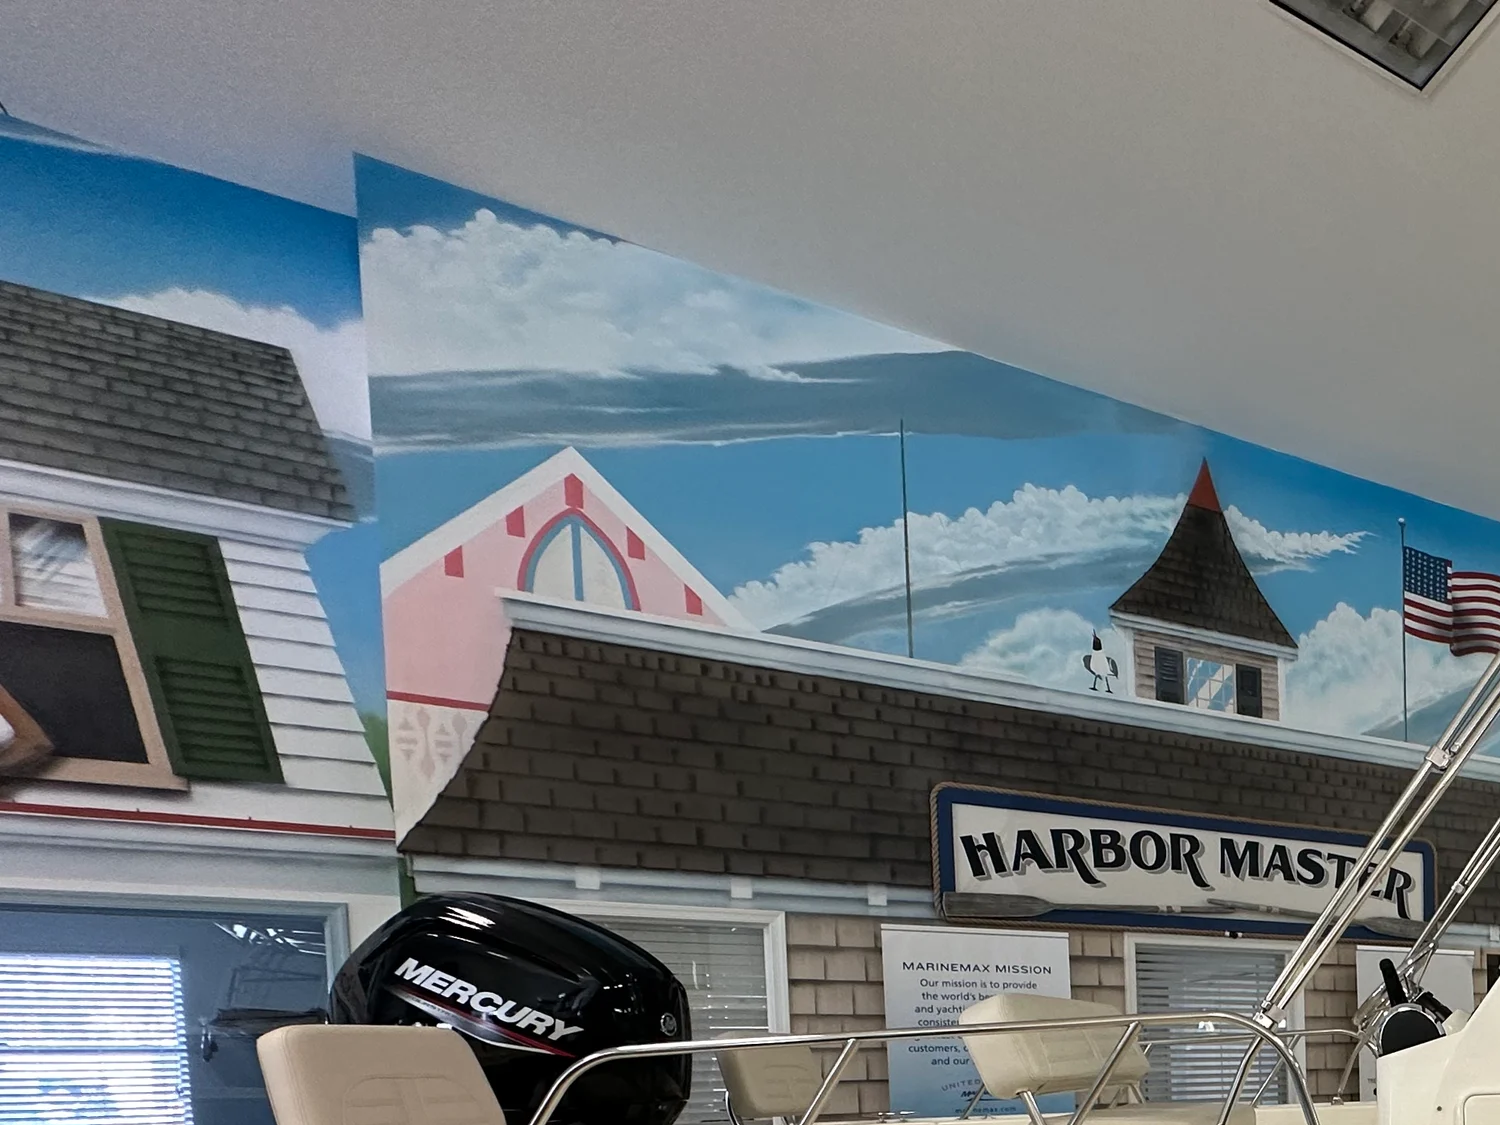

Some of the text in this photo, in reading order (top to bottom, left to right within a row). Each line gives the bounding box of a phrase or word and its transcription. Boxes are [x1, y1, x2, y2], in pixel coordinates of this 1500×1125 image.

[959, 828, 1413, 920] HARBOR MASTER
[902, 961, 1052, 975] MARINEMAX MISSION
[920, 978, 1037, 991] Our mission is to provide
[394, 957, 585, 1041] MERCURY
[921, 991, 939, 1001] the
[940, 991, 977, 1001] world's
[914, 1004, 934, 1014] and
[908, 1044, 961, 1054] customers,
[931, 1056, 970, 1066] and our
[941, 1078, 982, 1092] UNITED
